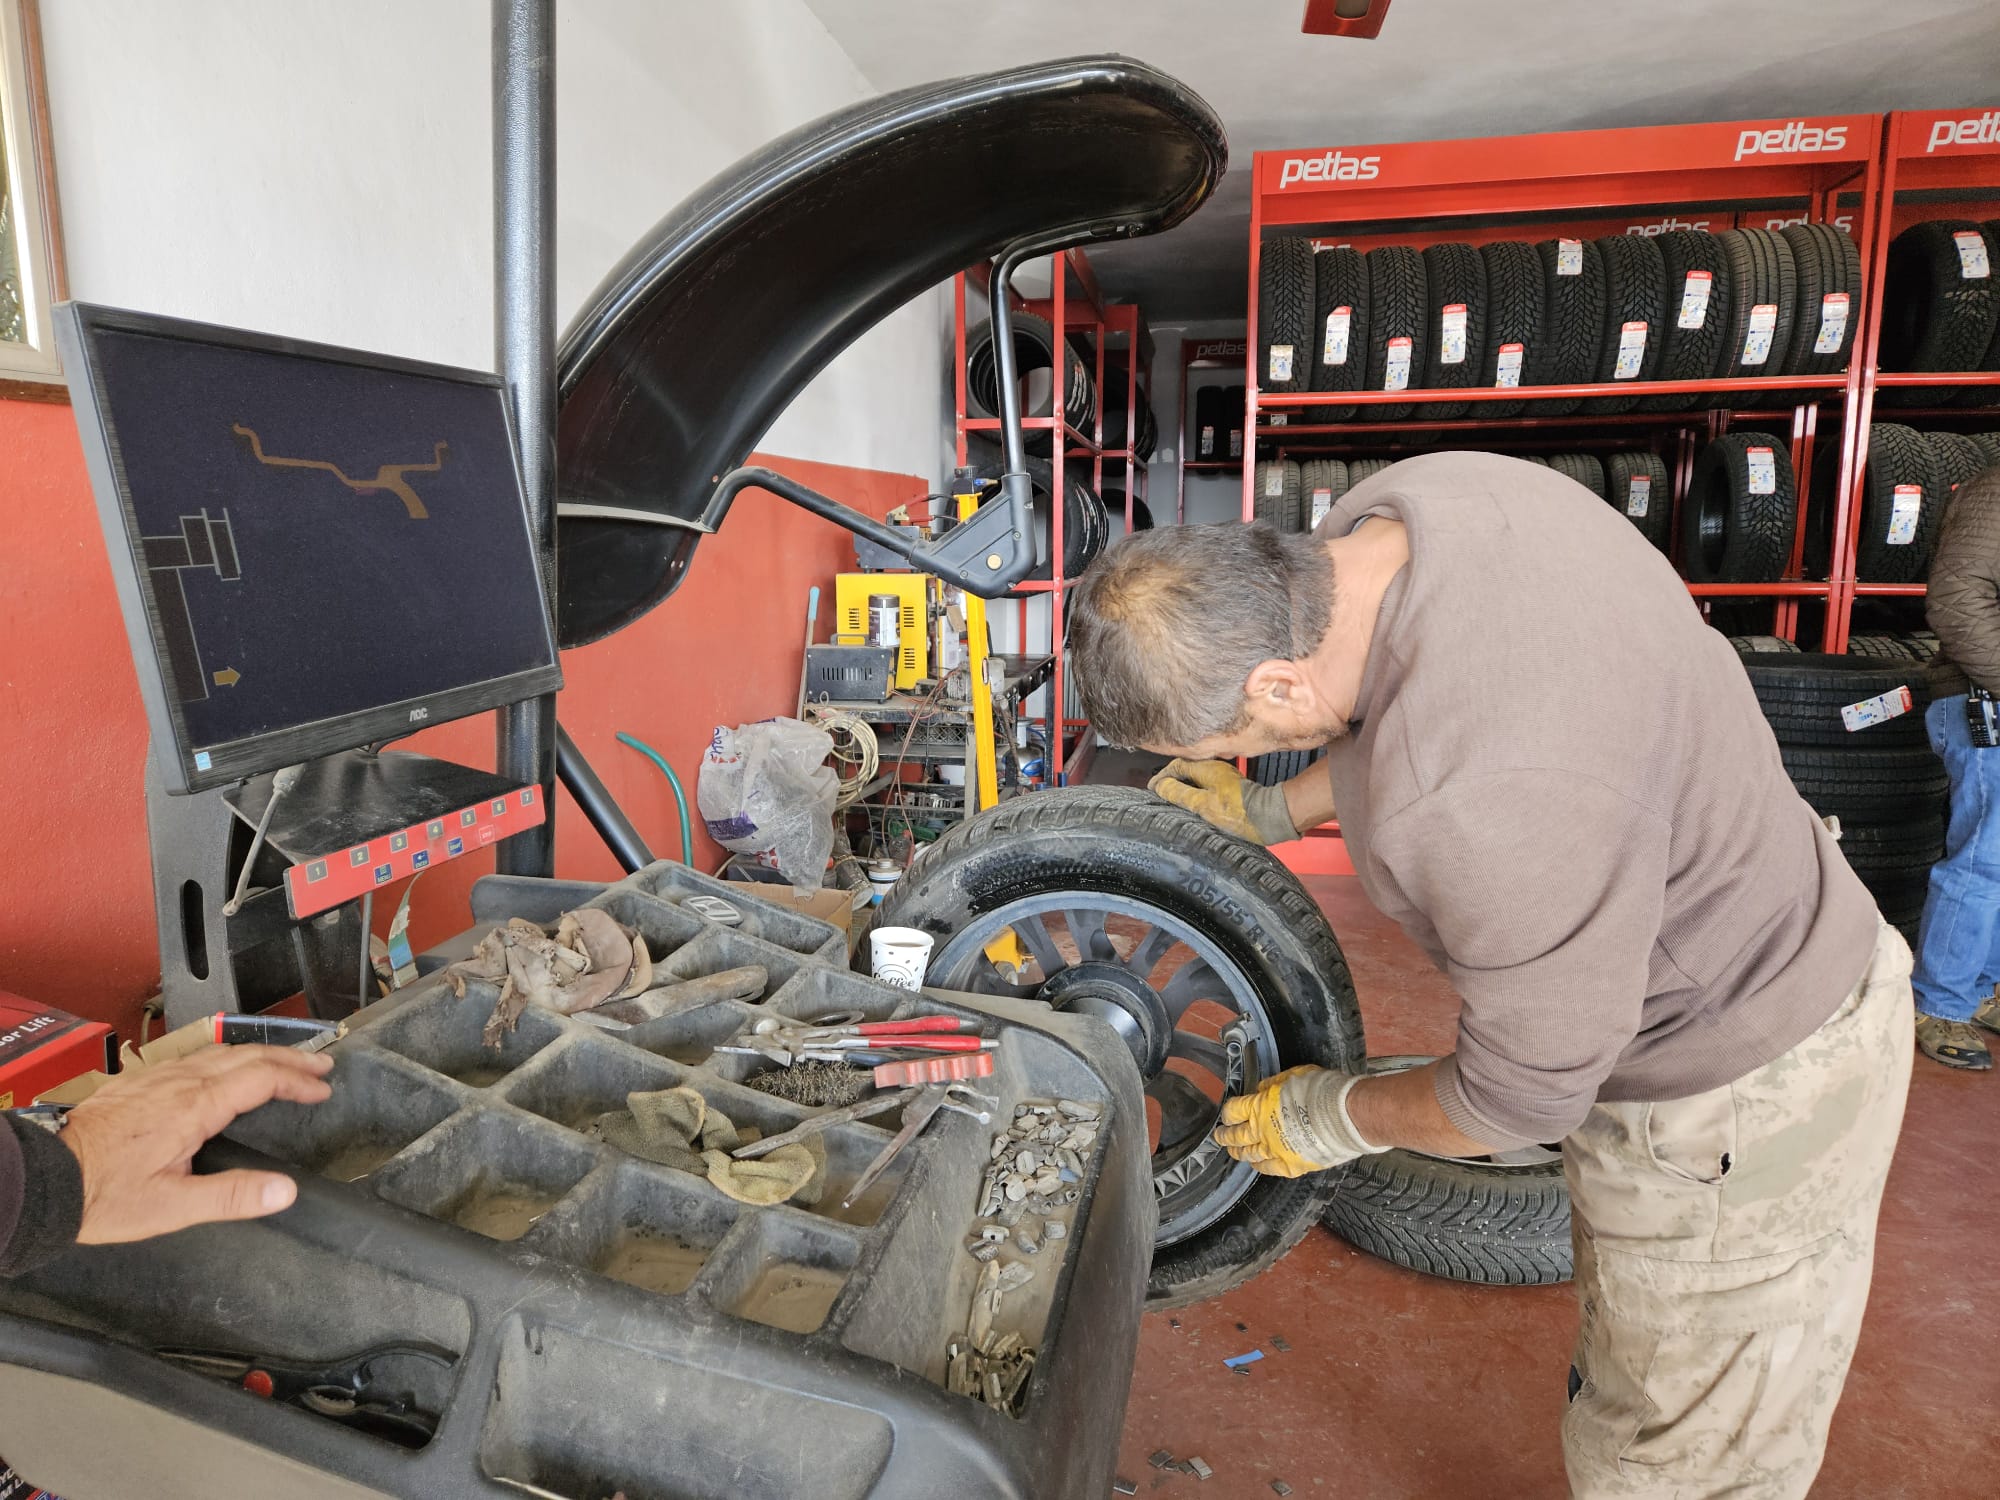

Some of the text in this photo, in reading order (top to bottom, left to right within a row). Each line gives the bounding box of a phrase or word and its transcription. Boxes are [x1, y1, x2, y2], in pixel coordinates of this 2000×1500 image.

[1734, 121, 1848, 161] petlas
[1926, 111, 2000, 153] petl
[1279, 151, 1381, 189] petlas
[1196, 340, 1247, 359] petlas
[409, 707, 428, 722] AOC
[19, 1015, 56, 1033] Lift
